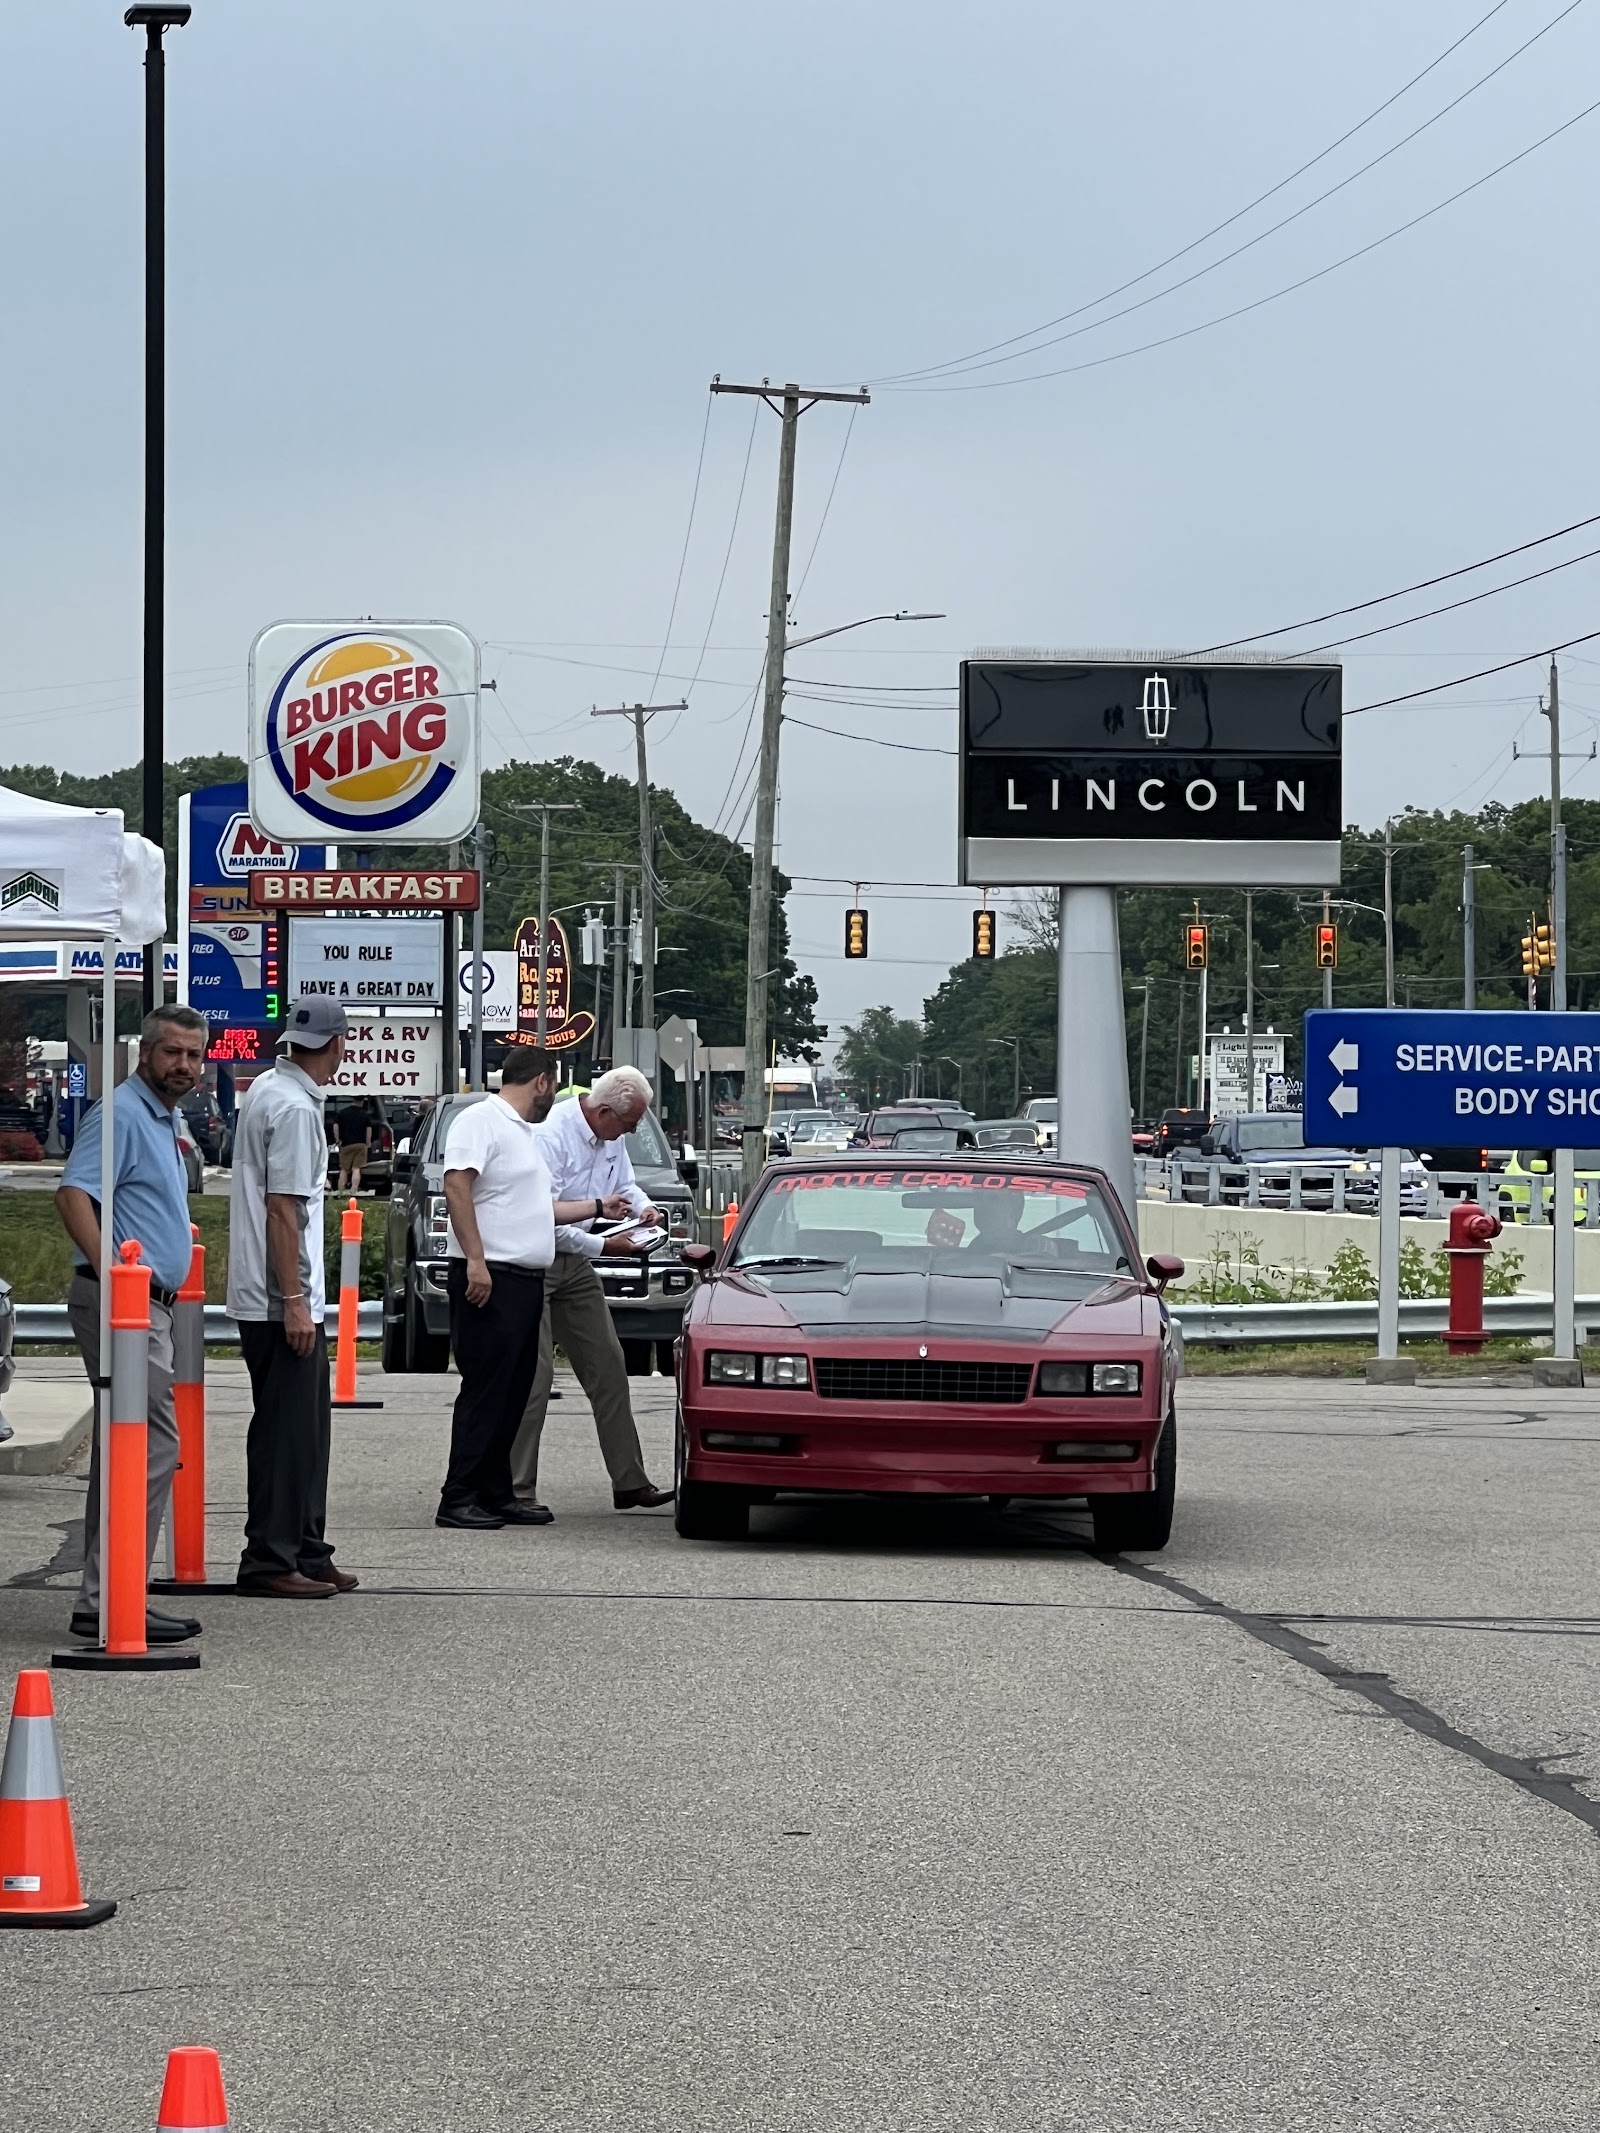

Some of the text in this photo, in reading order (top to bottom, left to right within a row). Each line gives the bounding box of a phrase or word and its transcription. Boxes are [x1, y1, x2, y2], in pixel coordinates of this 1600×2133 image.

[287, 665, 439, 739] BURGER
[294, 702, 447, 795] KING
[1007, 778, 1306, 812] LINCOLN
[228, 856, 286, 867] MARATHON
[2, 875, 59, 907] CARAVAN
[263, 876, 464, 900] BREAKFAST
[192, 943, 214, 954] REG
[323, 945, 393, 961] YOU RULE
[72, 950, 178, 970] MAATHN
[191, 976, 222, 986] PLUS
[519, 961, 564, 983] ROST
[300, 980, 435, 997] HAVE A GREAT DAY
[381, 1026, 395, 1041] &
[402, 1026, 430, 1041] RV
[342, 1049, 416, 1064] RKING
[1222, 1043, 1274, 1052] Lightouse
[326, 1071, 420, 1087] ACK LOT
[1455, 1087, 1540, 1115] BODY
[773, 1171, 1092, 1199] MONTE CARLO SS
